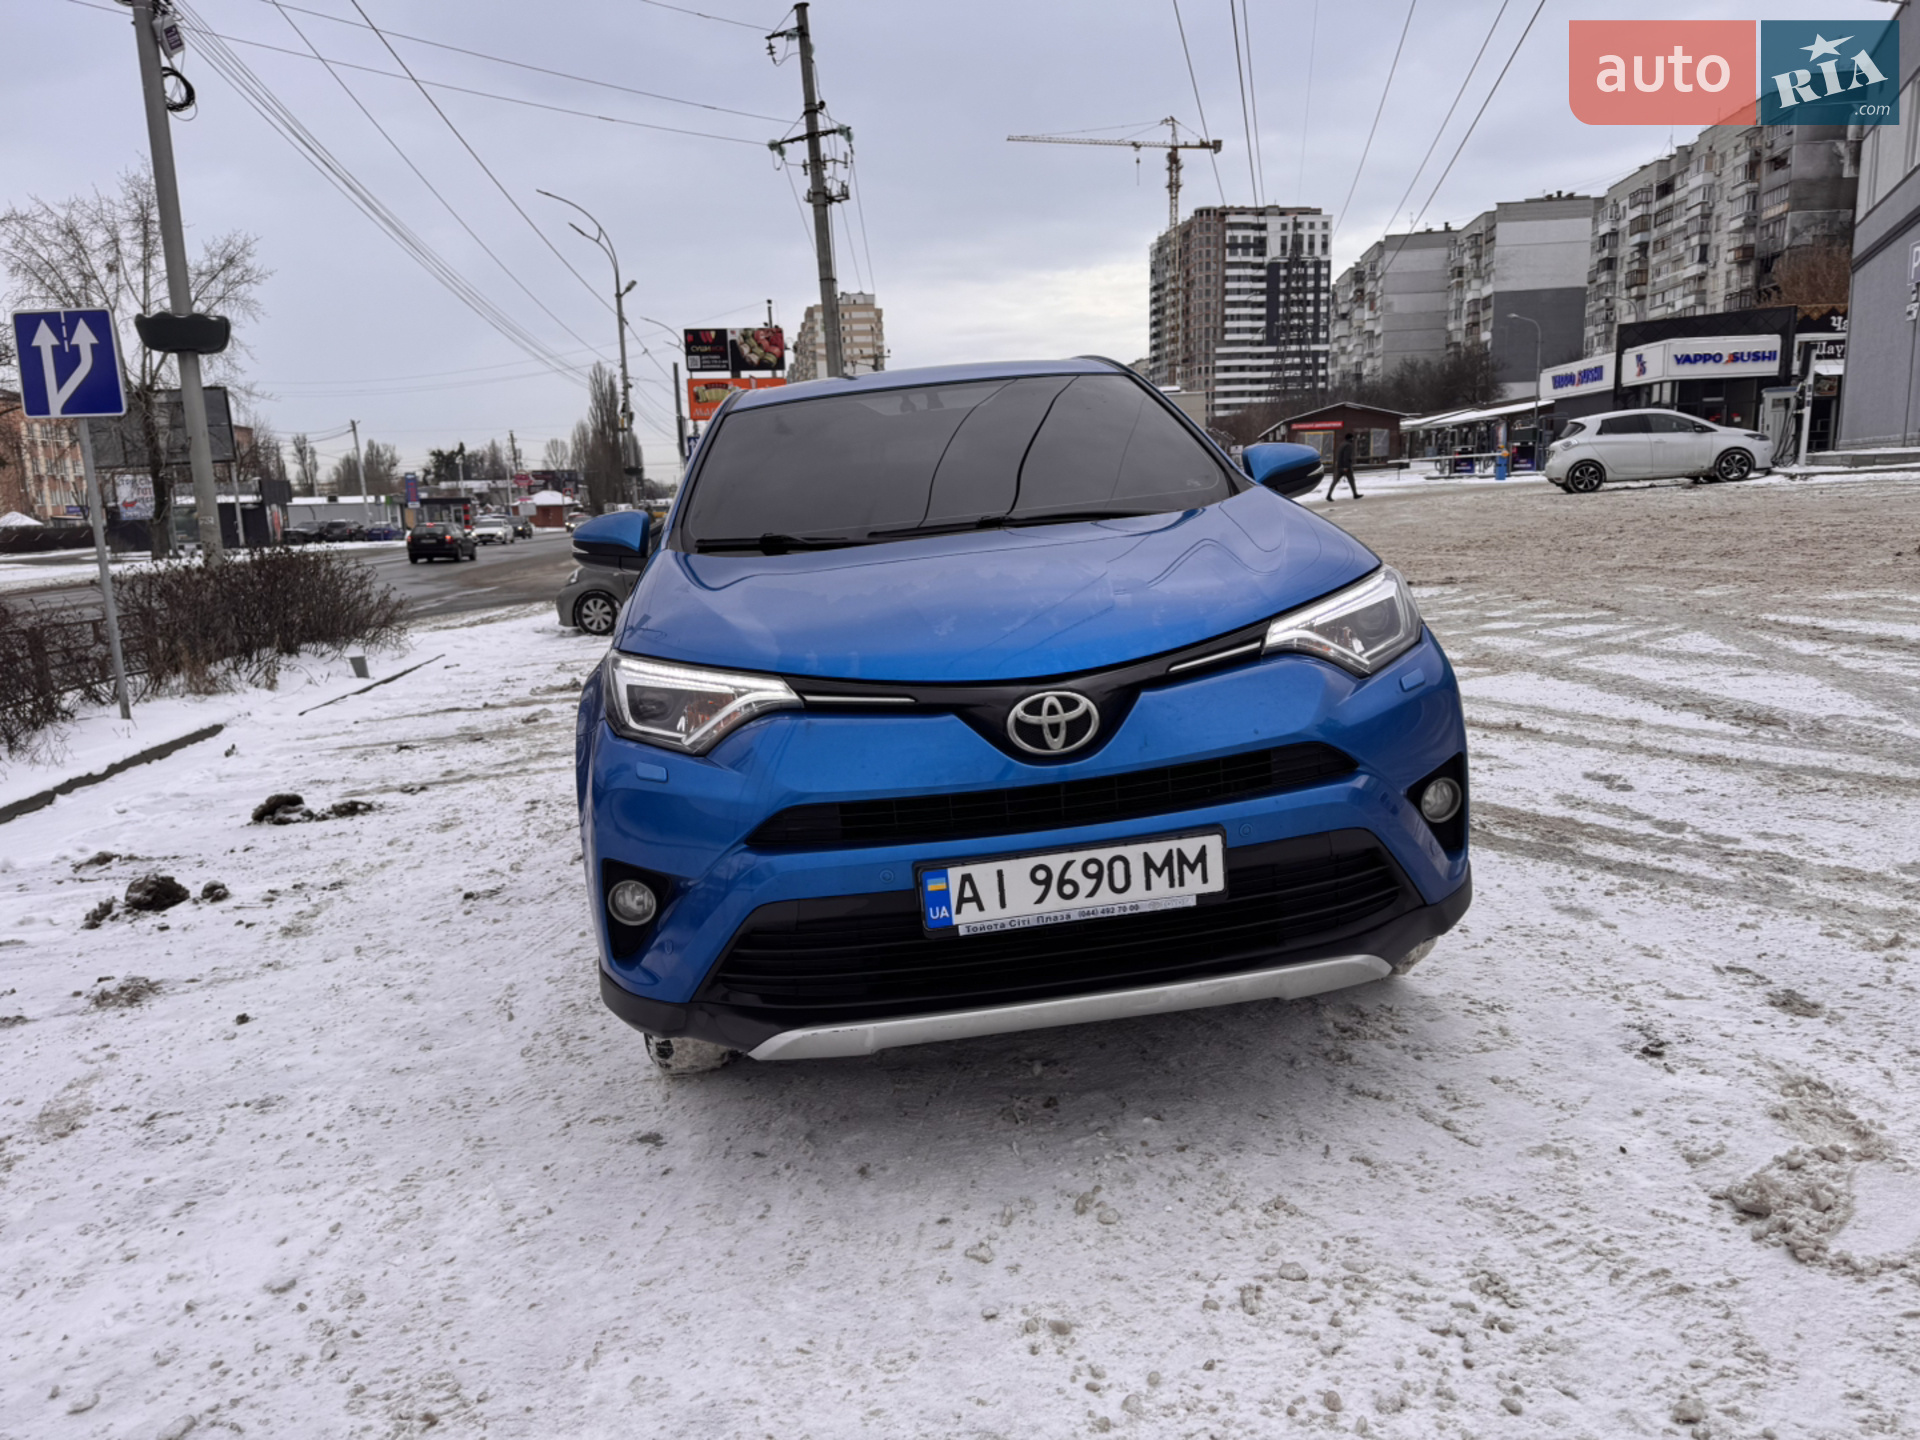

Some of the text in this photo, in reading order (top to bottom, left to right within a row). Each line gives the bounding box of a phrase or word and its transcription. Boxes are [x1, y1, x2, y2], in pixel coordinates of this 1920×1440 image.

[1673, 349, 1778, 366] YAPPO SUSHI
[1029, 854, 1132, 905] 9690
[1142, 844, 1209, 892] MM
[929, 905, 950, 921] UA
[965, 921, 1006, 934] Тойота
[1036, 913, 1072, 925] Плаза
[1077, 908, 1099, 919] (044)
[1100, 906, 1115, 916] 492
[1117, 905, 1127, 913] 70
[1129, 903, 1139, 912] 00
